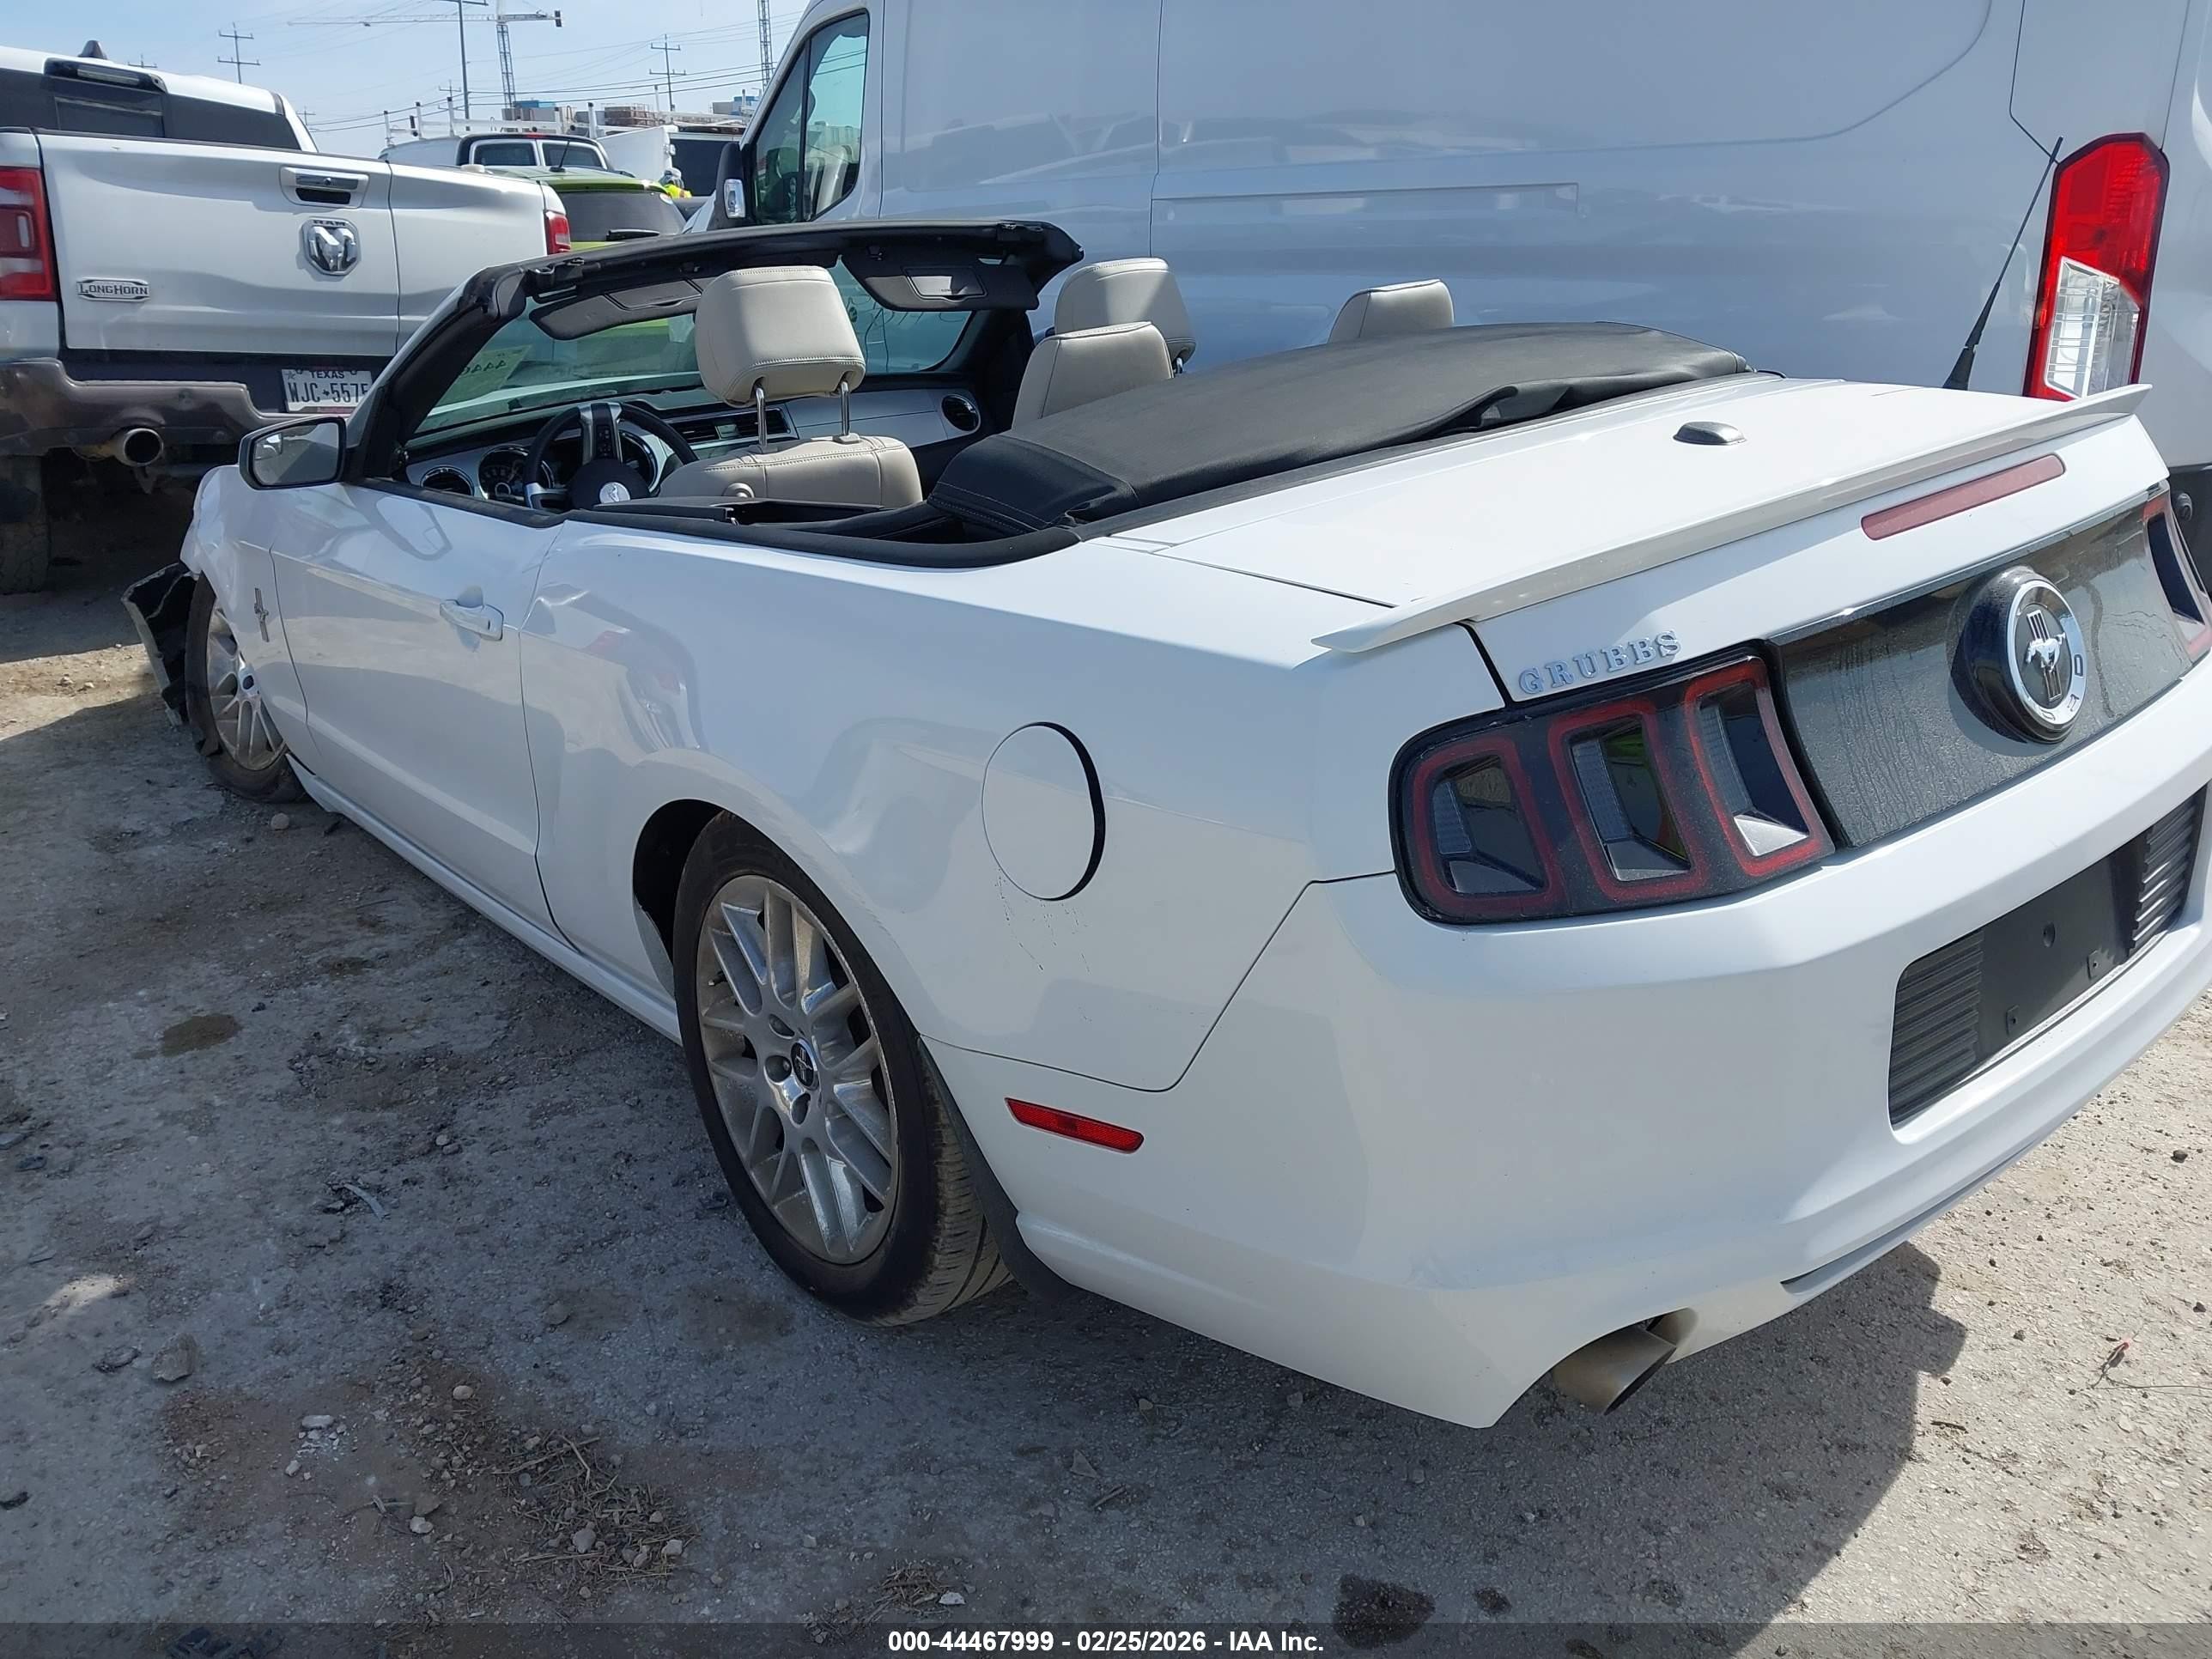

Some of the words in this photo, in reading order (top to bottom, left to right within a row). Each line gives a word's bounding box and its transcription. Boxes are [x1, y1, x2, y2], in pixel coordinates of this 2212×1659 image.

[79, 283, 149, 295] LONGHORN
[311, 370, 345, 379] TEXAS
[1518, 629, 1682, 696] GRUBBS
